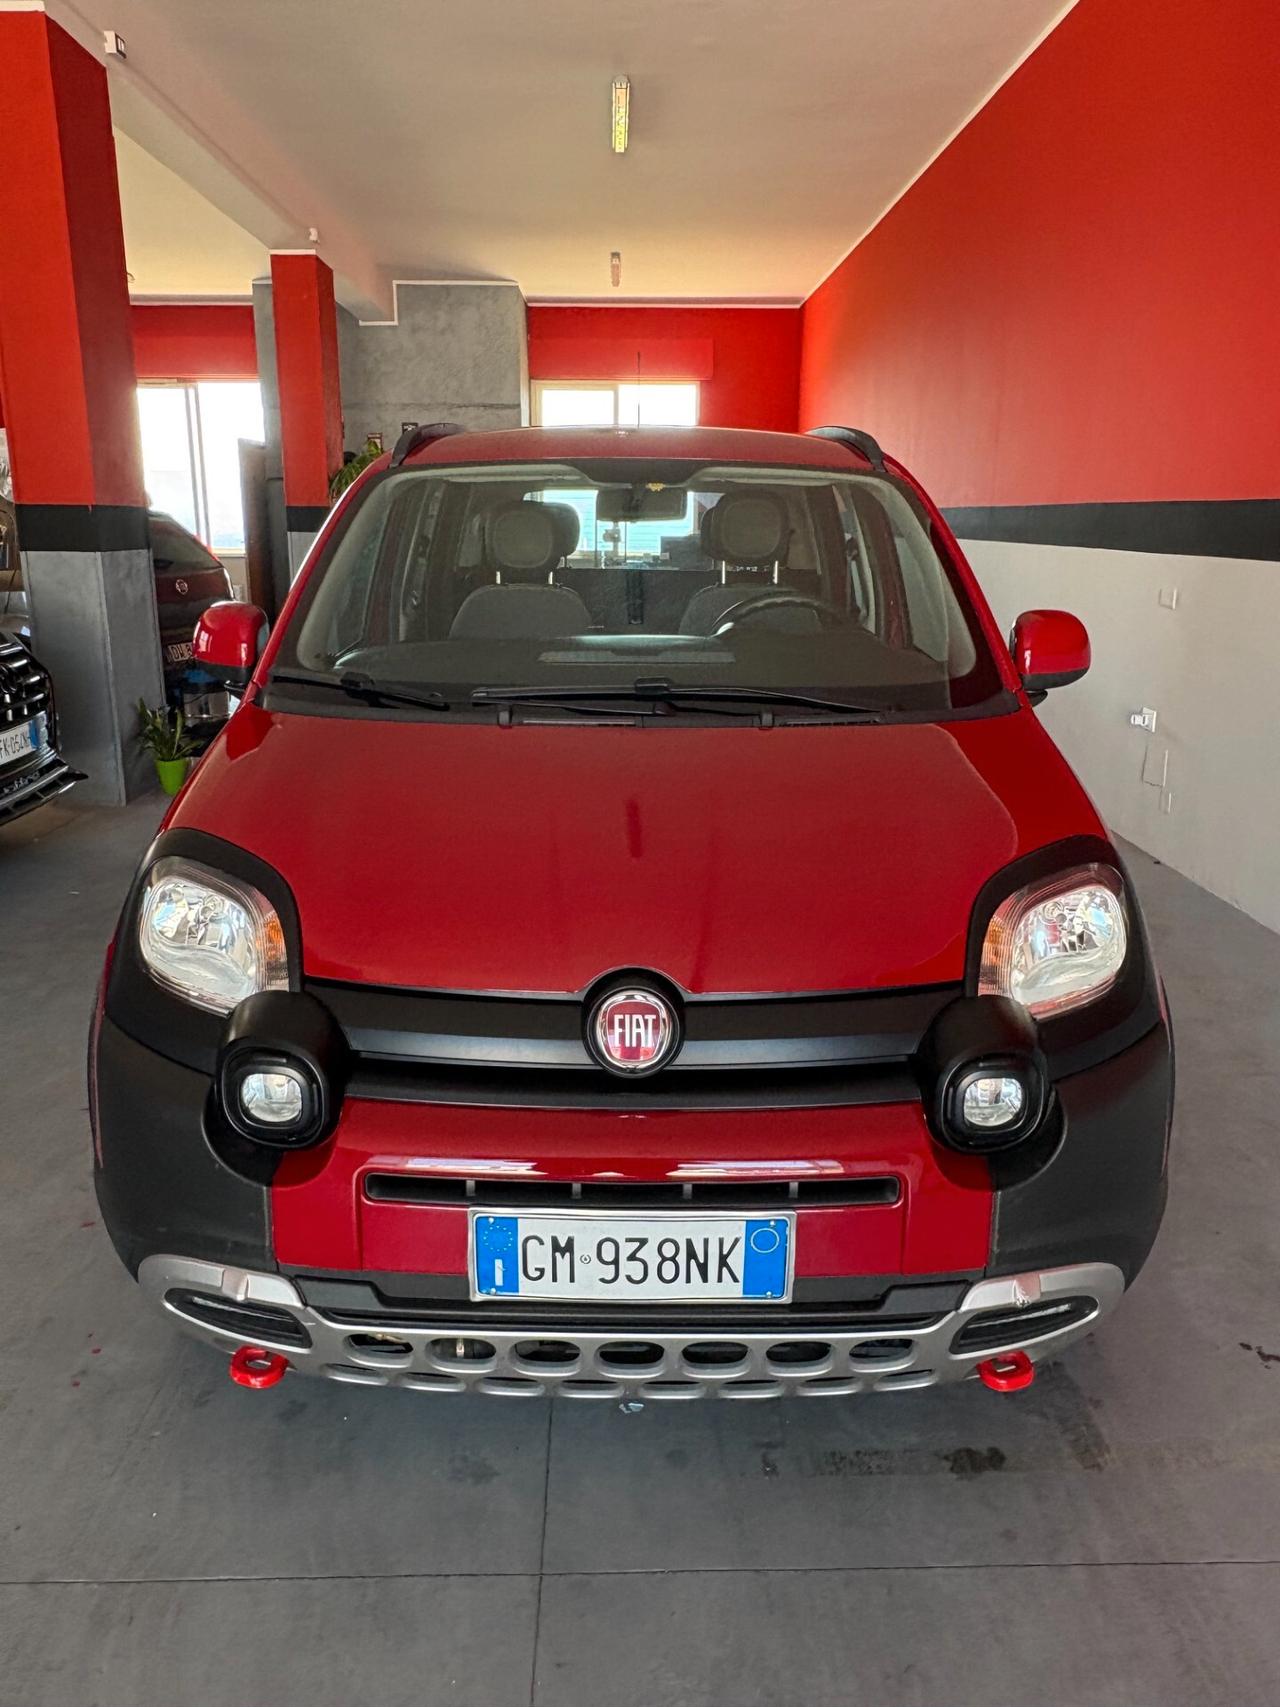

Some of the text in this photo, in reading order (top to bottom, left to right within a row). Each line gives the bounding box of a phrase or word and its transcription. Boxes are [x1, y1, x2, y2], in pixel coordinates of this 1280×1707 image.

[613, 1014, 657, 1048] FIAT
[521, 1234, 742, 1285] GM 938NK
